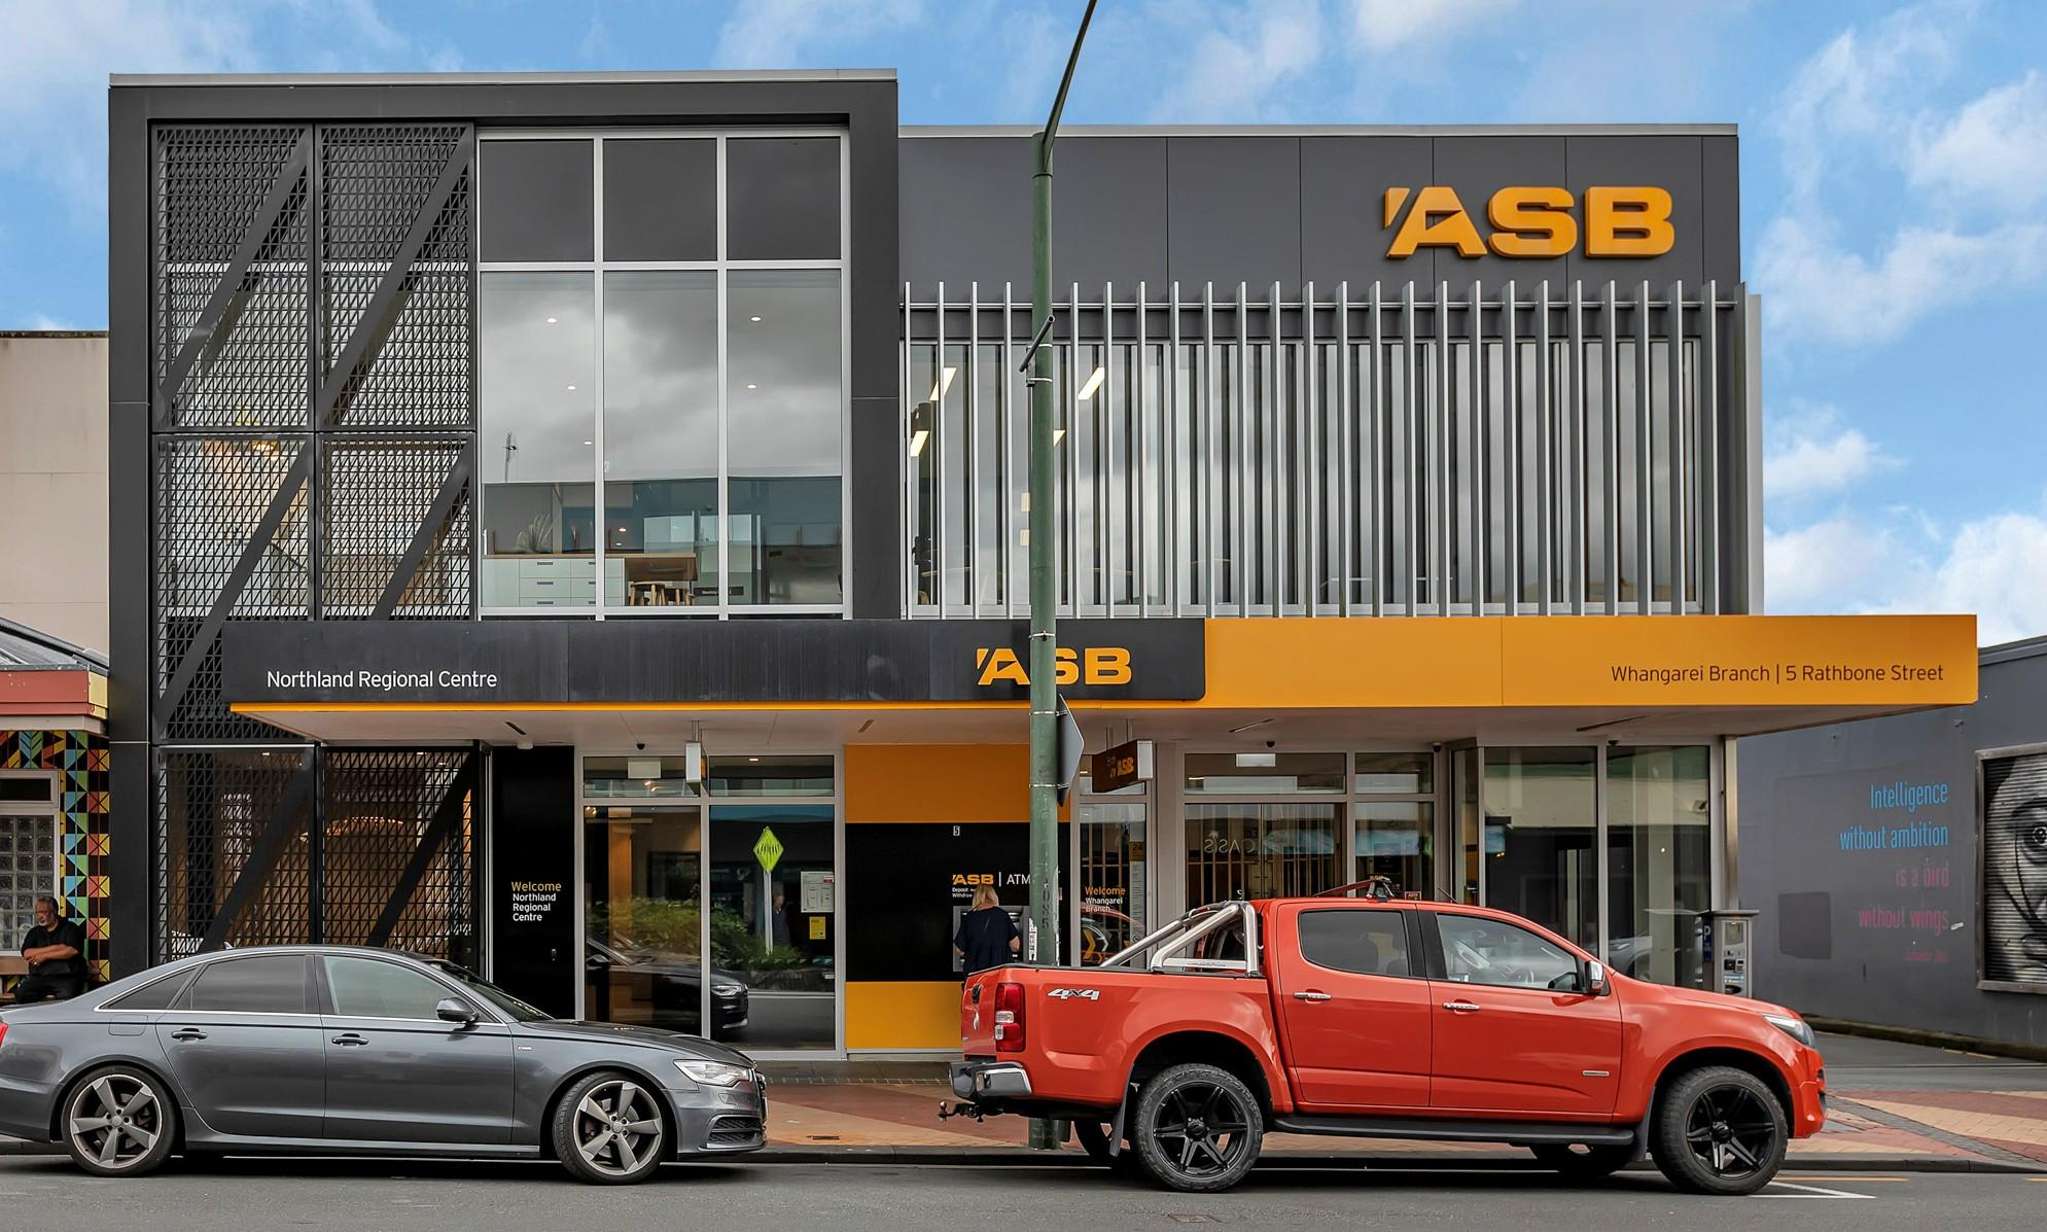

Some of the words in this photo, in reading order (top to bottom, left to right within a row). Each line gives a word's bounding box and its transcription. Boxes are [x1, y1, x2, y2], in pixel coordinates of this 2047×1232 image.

[1384, 186, 1675, 258] ASB
[267, 670, 353, 688] Northland
[358, 670, 433, 691] Regional
[438, 671, 497, 688] Centre
[1611, 665, 1704, 686] Whangarei
[1709, 665, 1770, 681] Branch
[1785, 665, 1797, 681] 5
[1802, 664, 1885, 681] Rathbone
[1891, 664, 1944, 681] Street
[1871, 782, 1948, 813] Intelligence
[1840, 825, 1887, 850] without
[1890, 821, 1948, 848] ambition
[951, 874, 994, 885] ASB
[1006, 874, 1031, 885] ATM
[511, 881, 562, 892] Welcome
[1085, 885, 1126, 896] Welcome
[512, 893, 556, 902] Northland
[1085, 896, 1123, 905] Whangarei
[512, 903, 551, 913] Regional
[1085, 904, 1111, 912] Branch
[512, 912, 543, 922] Centre
